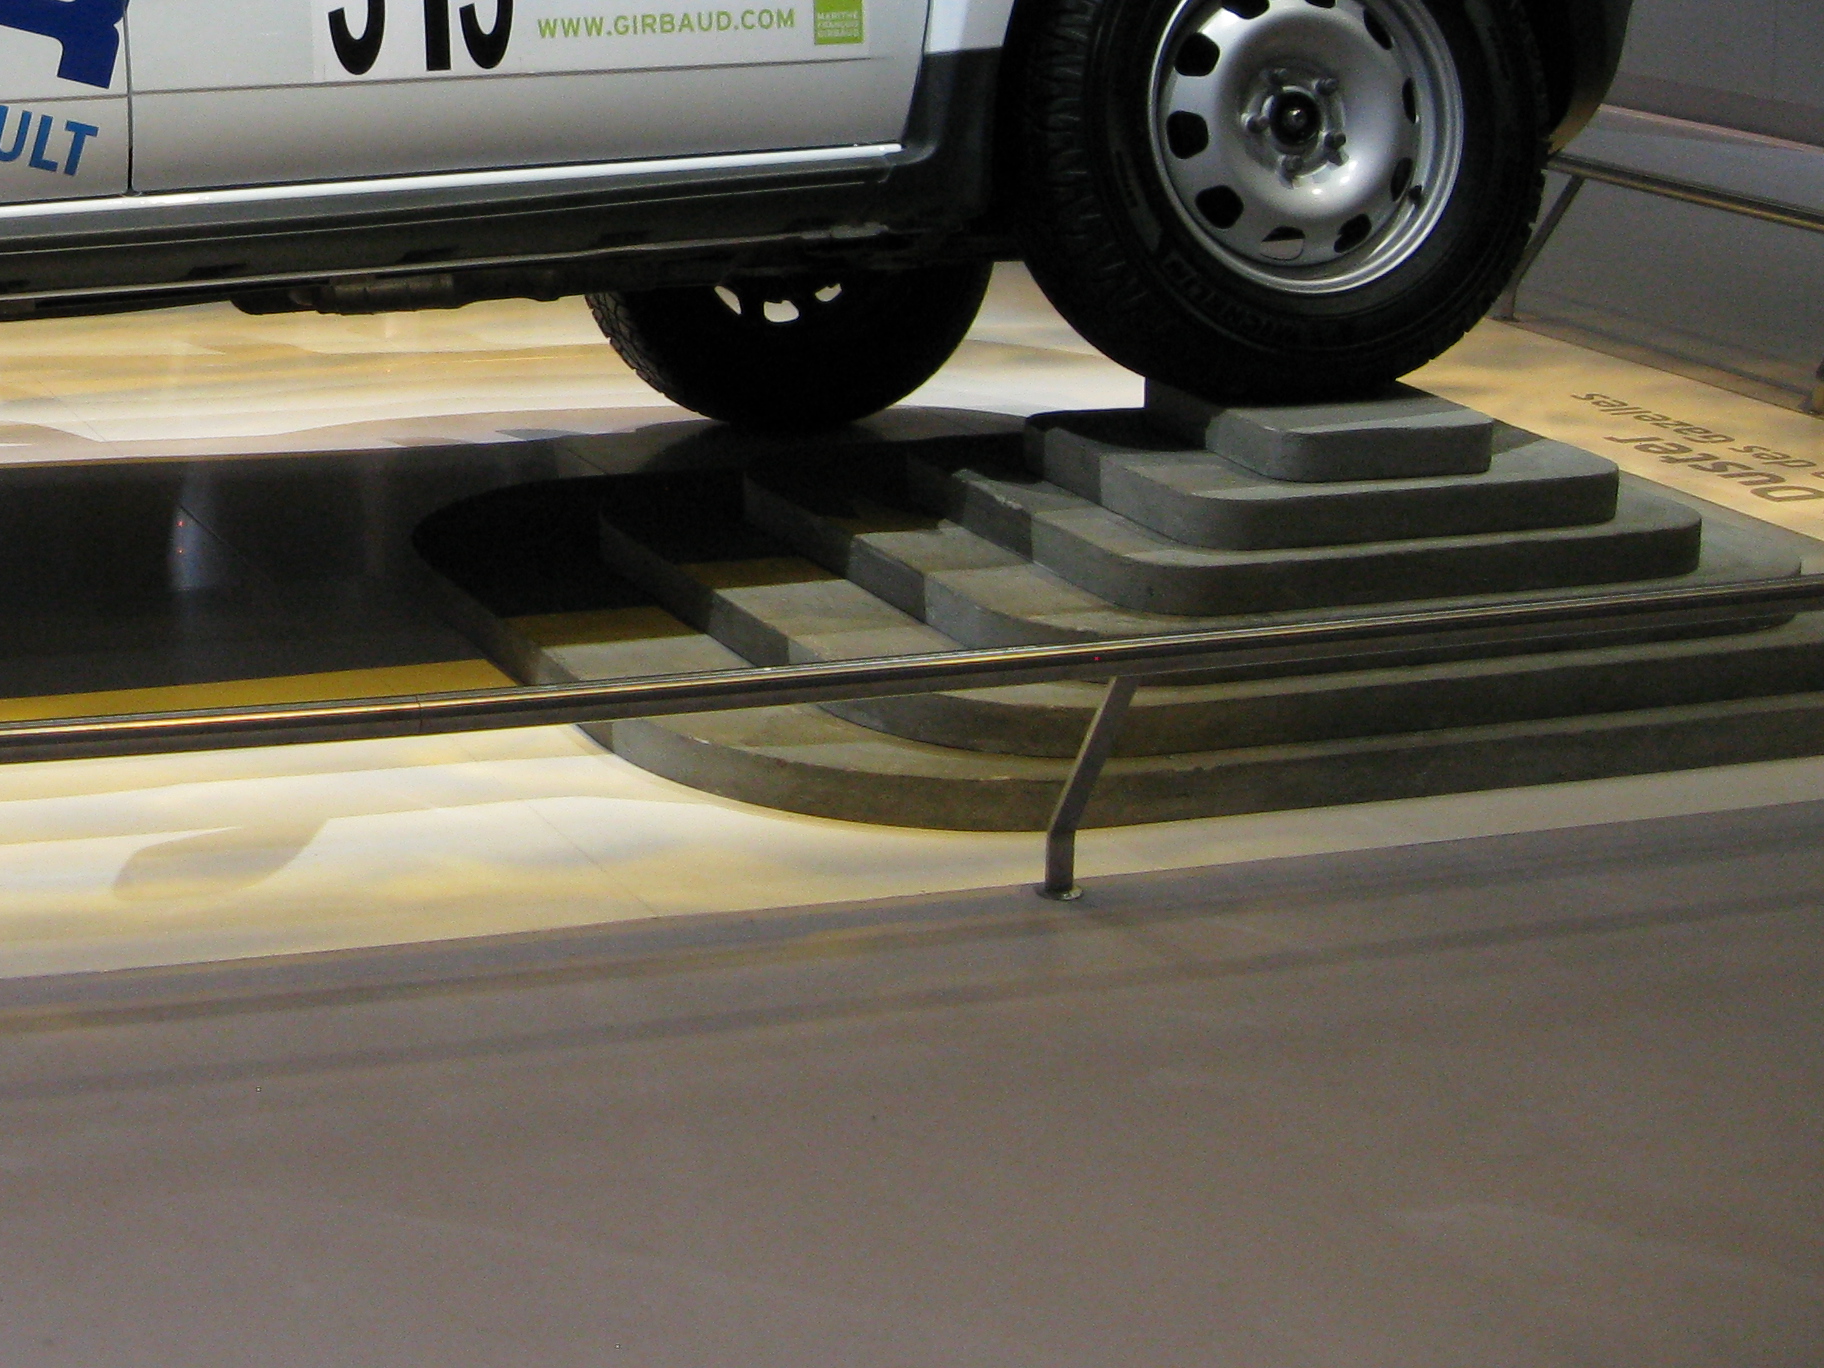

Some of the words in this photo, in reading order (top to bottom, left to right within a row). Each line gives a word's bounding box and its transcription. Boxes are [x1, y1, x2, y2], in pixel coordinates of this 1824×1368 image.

[537, 8, 795, 38] WWW.GIRBAUD.COM
[1570, 393, 1735, 443] Gazelles
[1604, 436, 1824, 502] Duster
[1729, 445, 1817, 468] des
